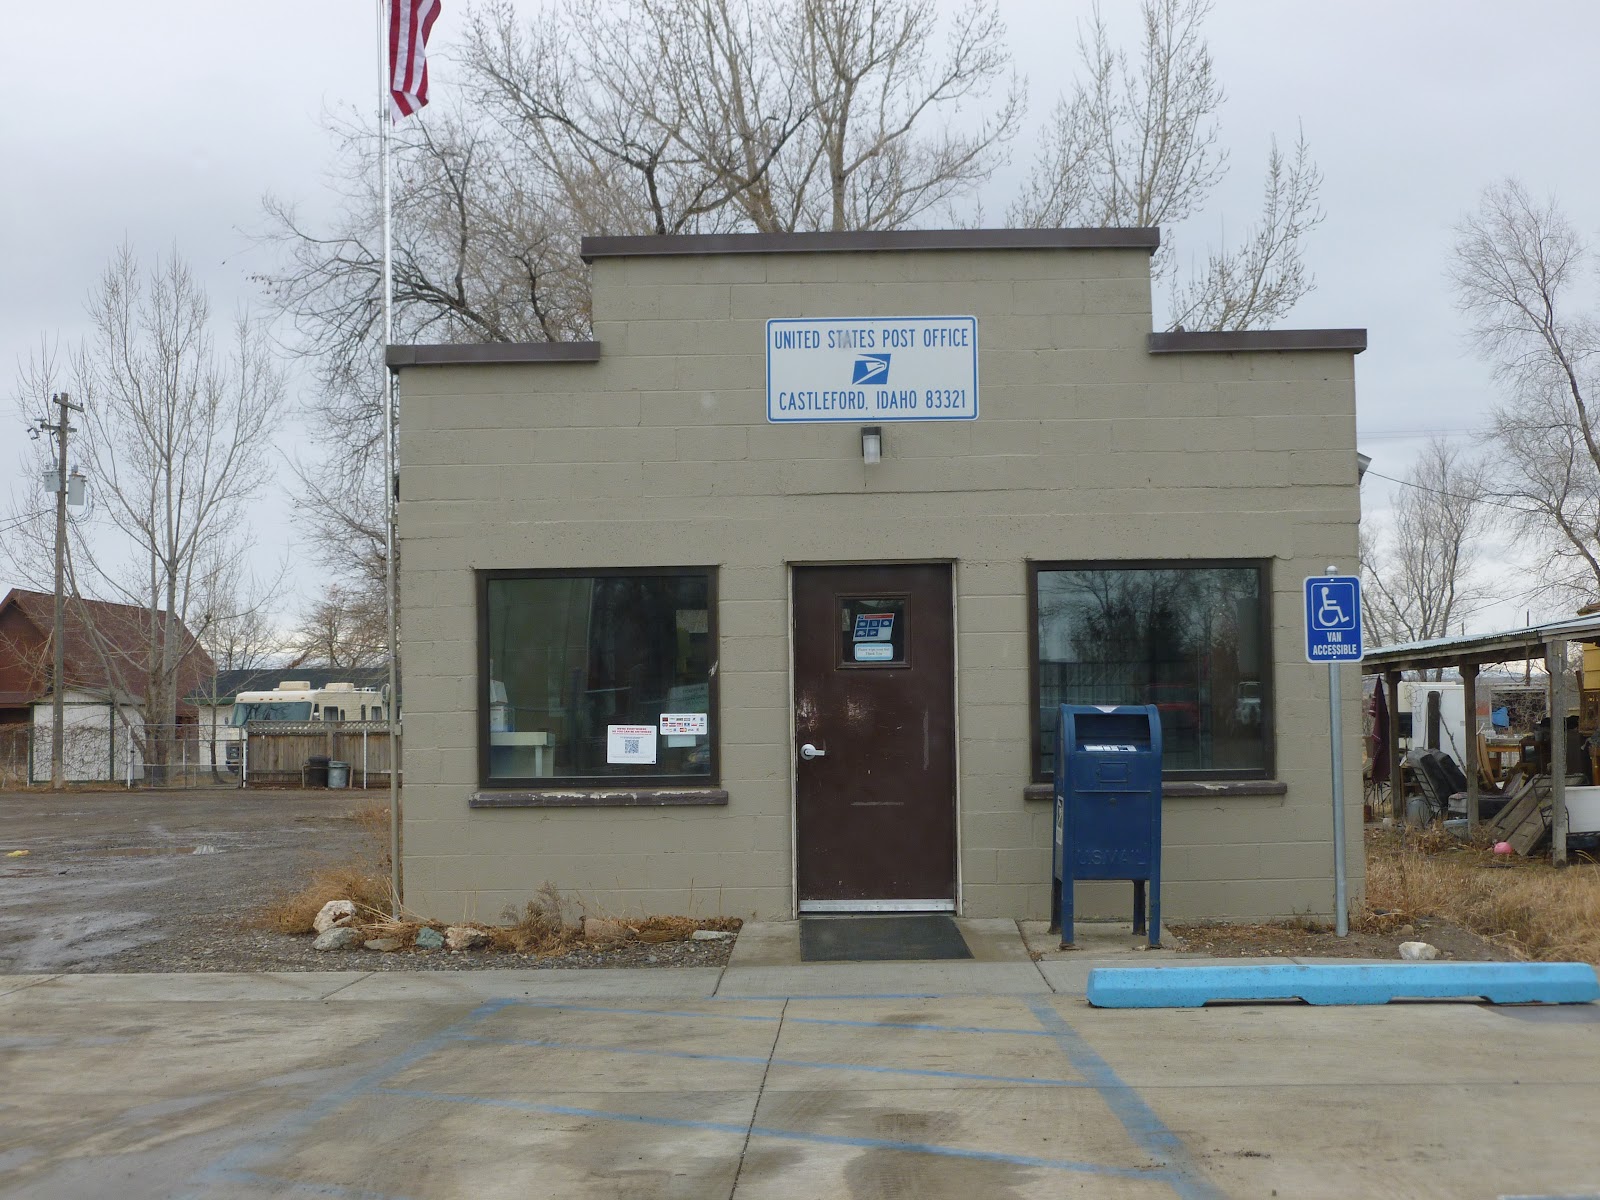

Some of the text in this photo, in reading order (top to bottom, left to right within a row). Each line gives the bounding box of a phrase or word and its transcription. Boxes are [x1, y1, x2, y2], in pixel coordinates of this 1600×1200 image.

[774, 328, 969, 349] UNITED STATES POST OFFICE
[779, 389, 966, 411] CASTLEFORD, IDAHO 83321
[1326, 632, 1342, 642] VAN
[1312, 644, 1357, 655] ACCESSIBLE
